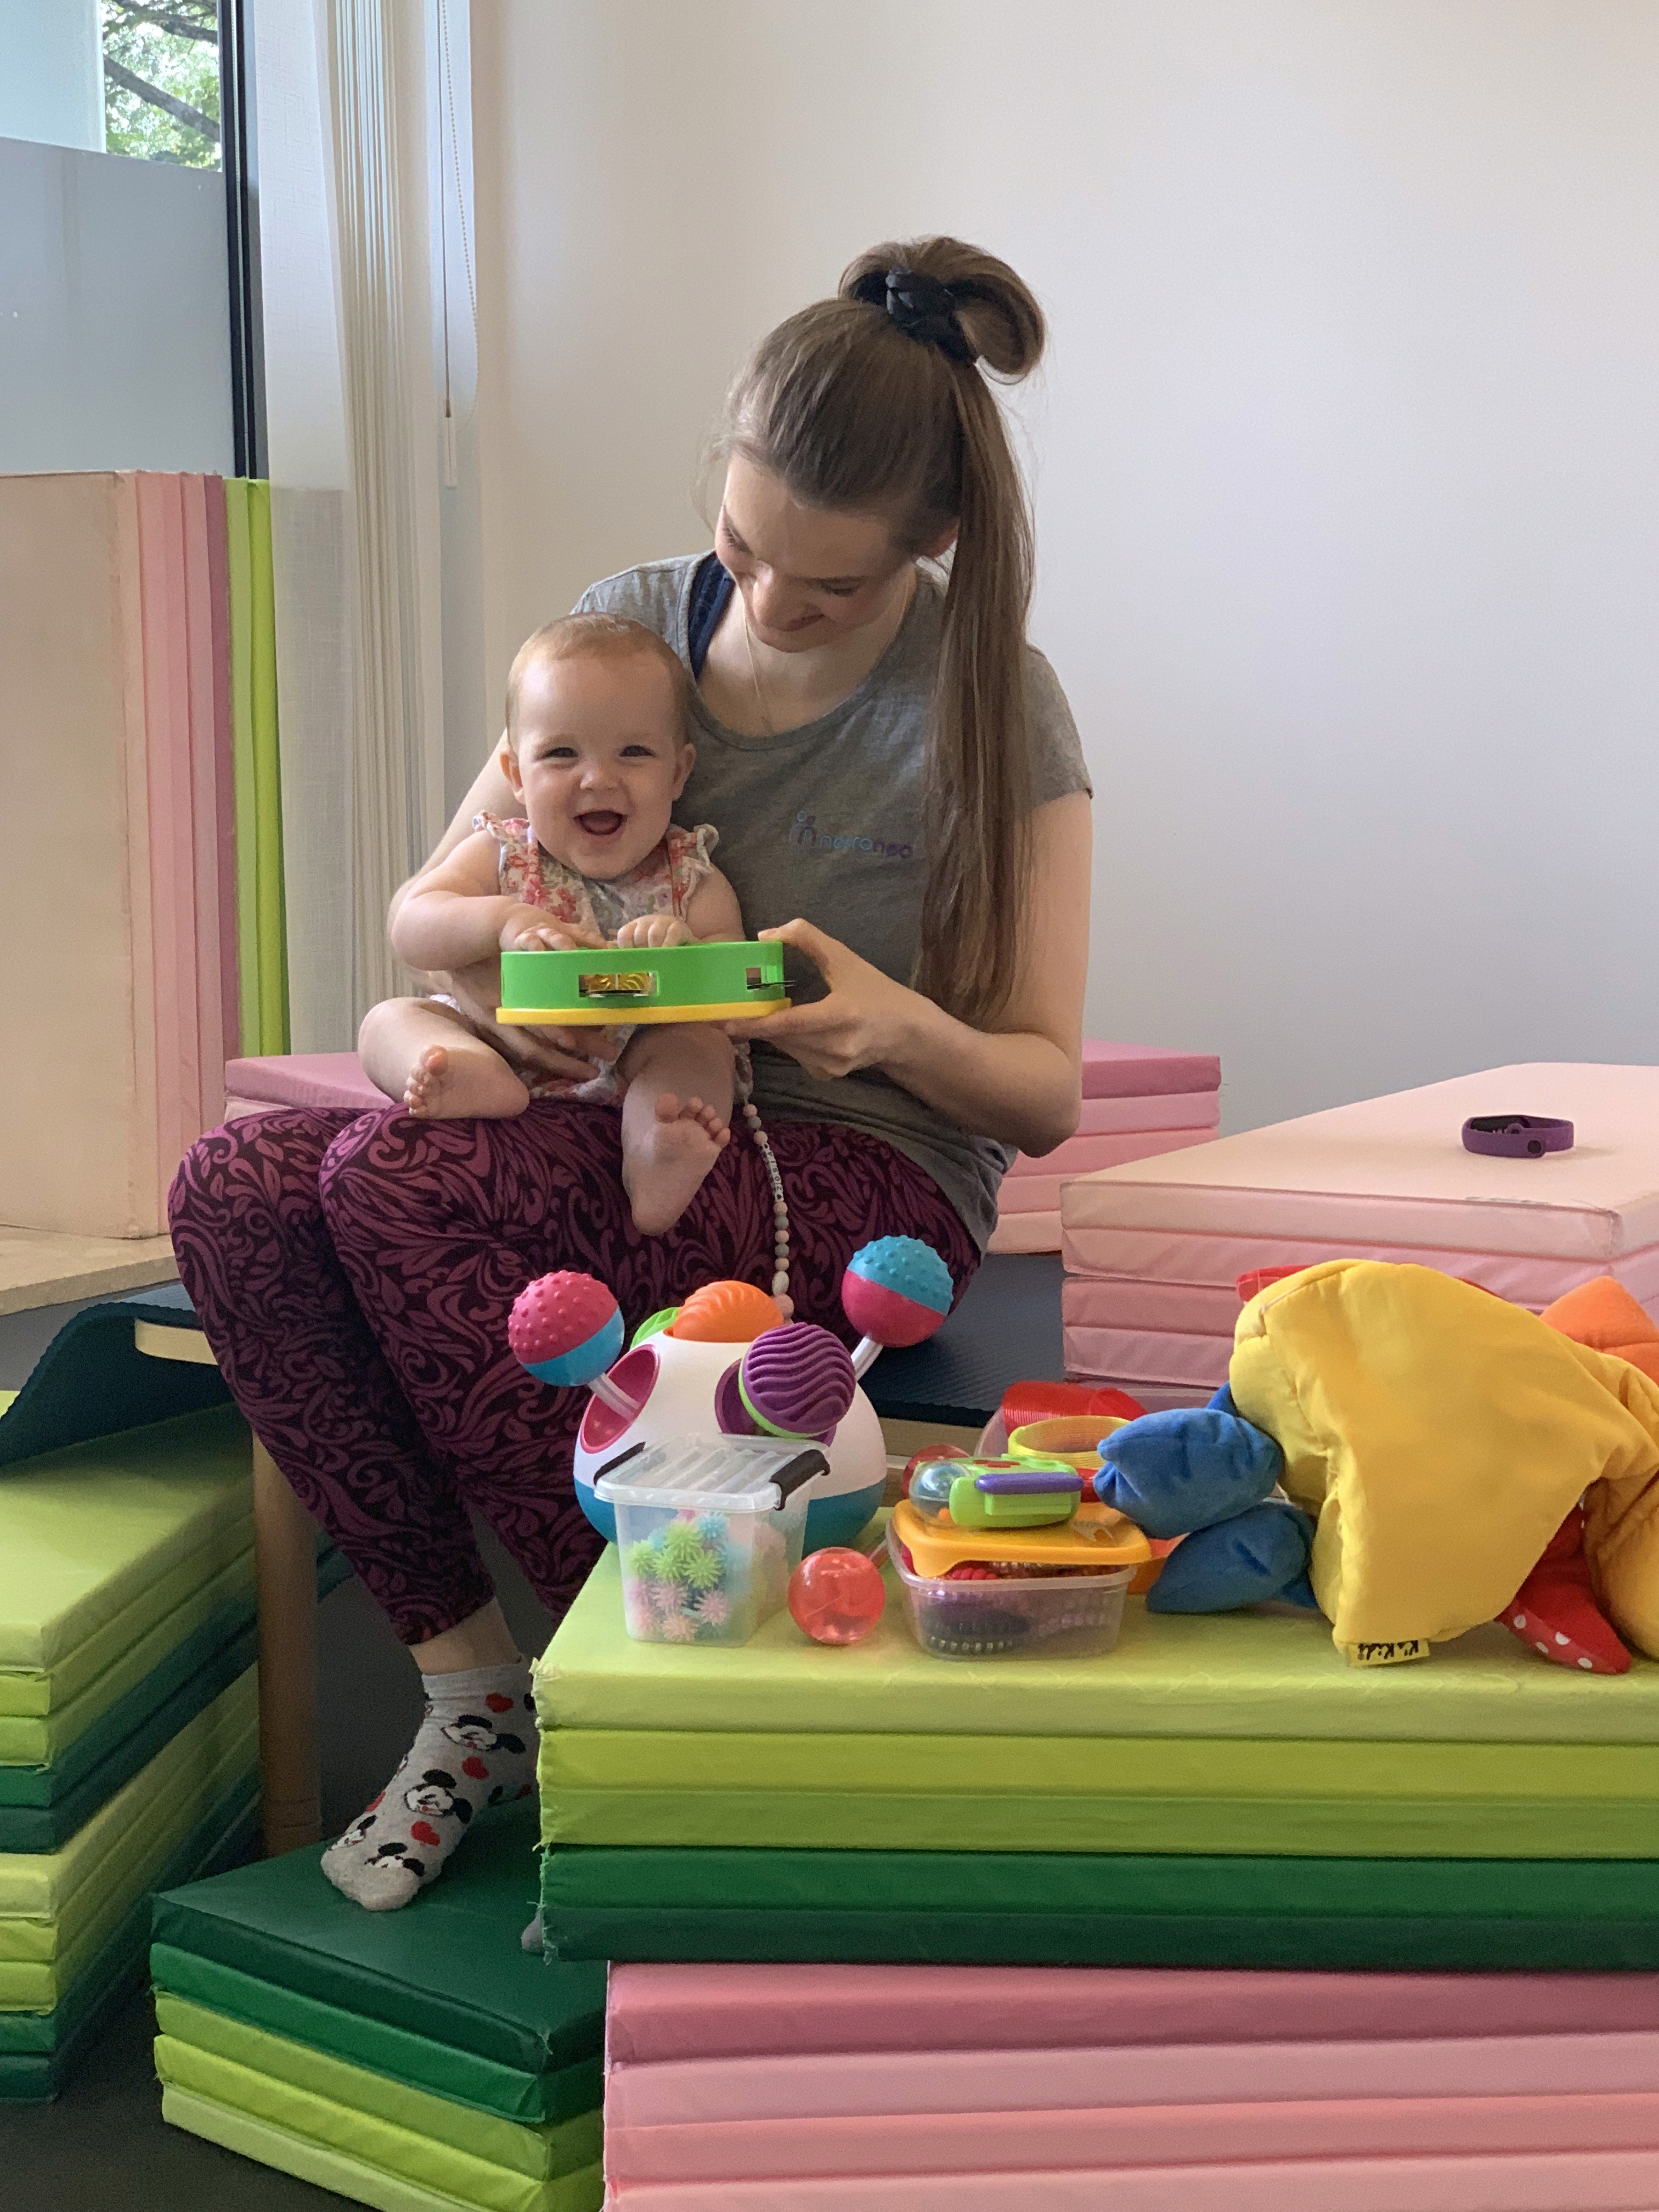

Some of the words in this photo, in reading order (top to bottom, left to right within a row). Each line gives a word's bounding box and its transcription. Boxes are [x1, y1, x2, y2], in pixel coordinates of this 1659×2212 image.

[820, 835, 913, 859] neuroneo
[1357, 1643, 1395, 1661] Kids
[1397, 1639, 1418, 1656] K's
